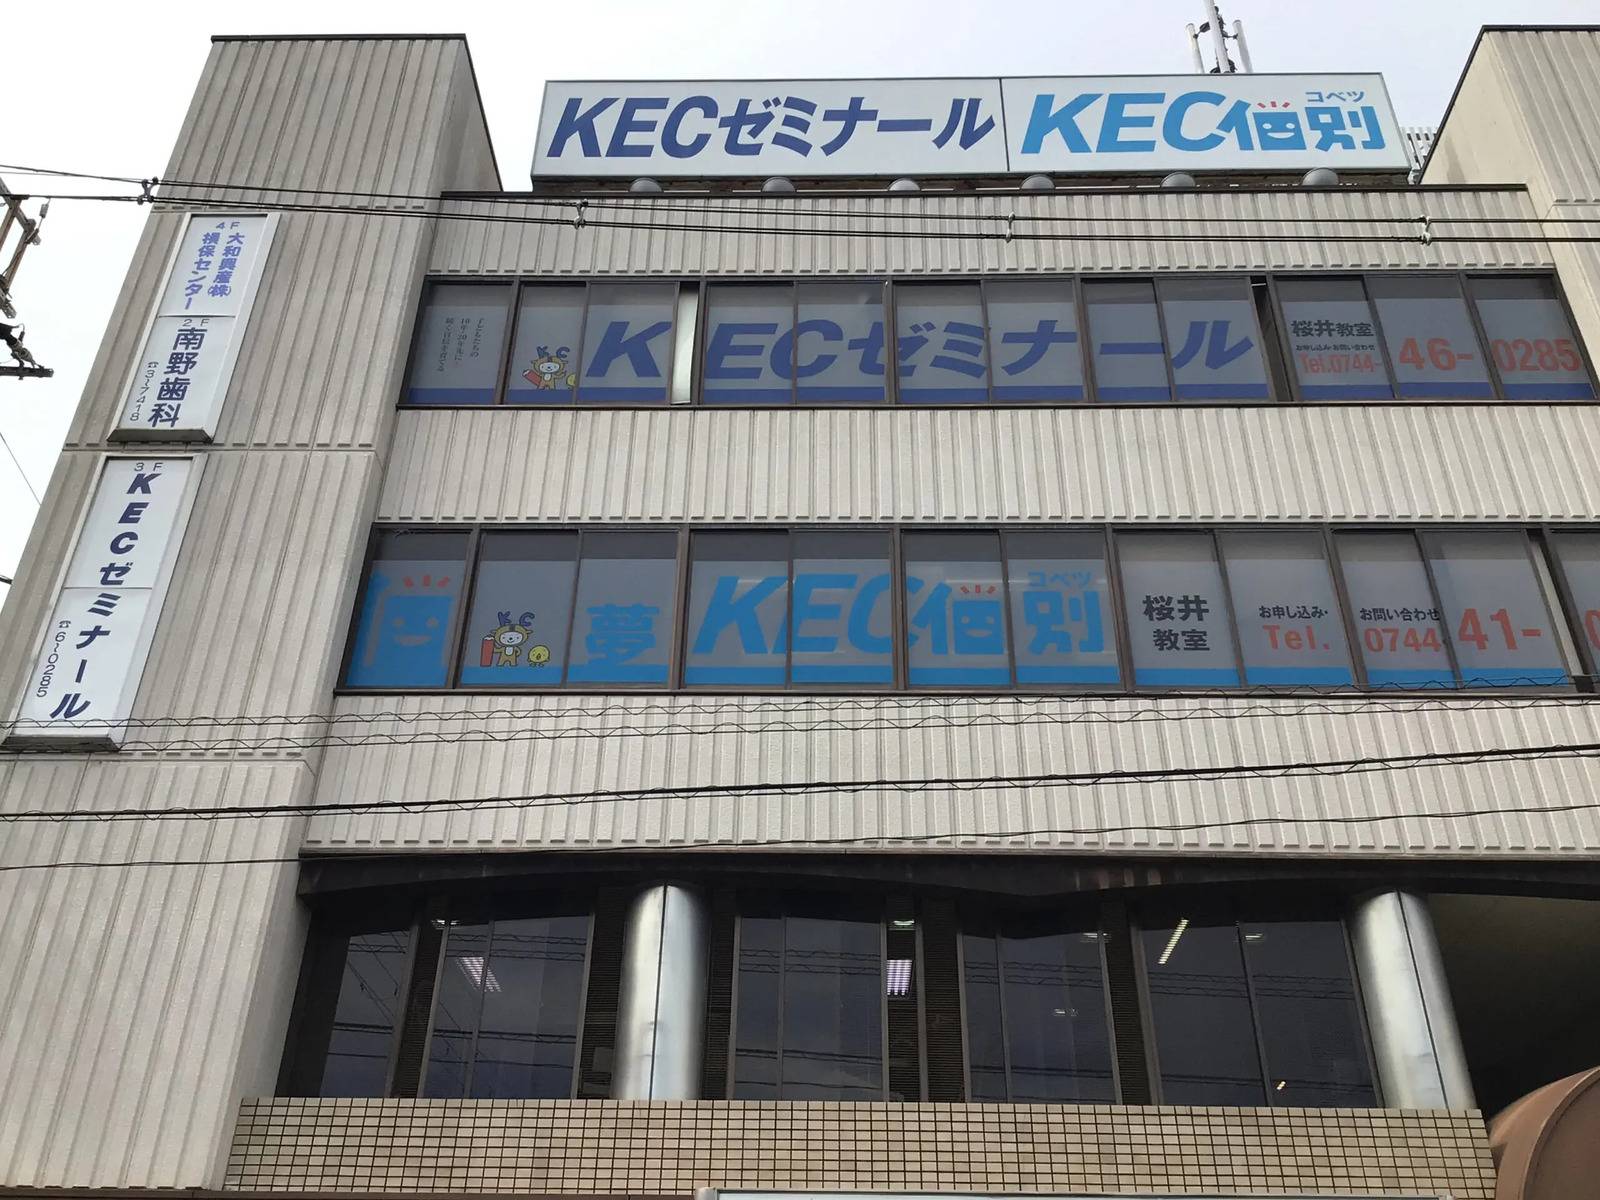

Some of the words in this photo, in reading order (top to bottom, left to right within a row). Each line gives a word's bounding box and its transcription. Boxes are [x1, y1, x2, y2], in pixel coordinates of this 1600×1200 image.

[1305, 91, 1365, 103] コベツ
[547, 95, 996, 158] KECゼミナール
[185, 232, 220, 310] 損保センター
[1291, 319, 1375, 337] 桜井教室
[148, 327, 208, 428] 南野歯科
[134, 462, 163, 472] 3F
[1027, 571, 1092, 588] コベツ
[50, 472, 161, 719] KECゼミナール
[1142, 595, 1210, 622] 桜井
[1153, 628, 1210, 652] 教室
